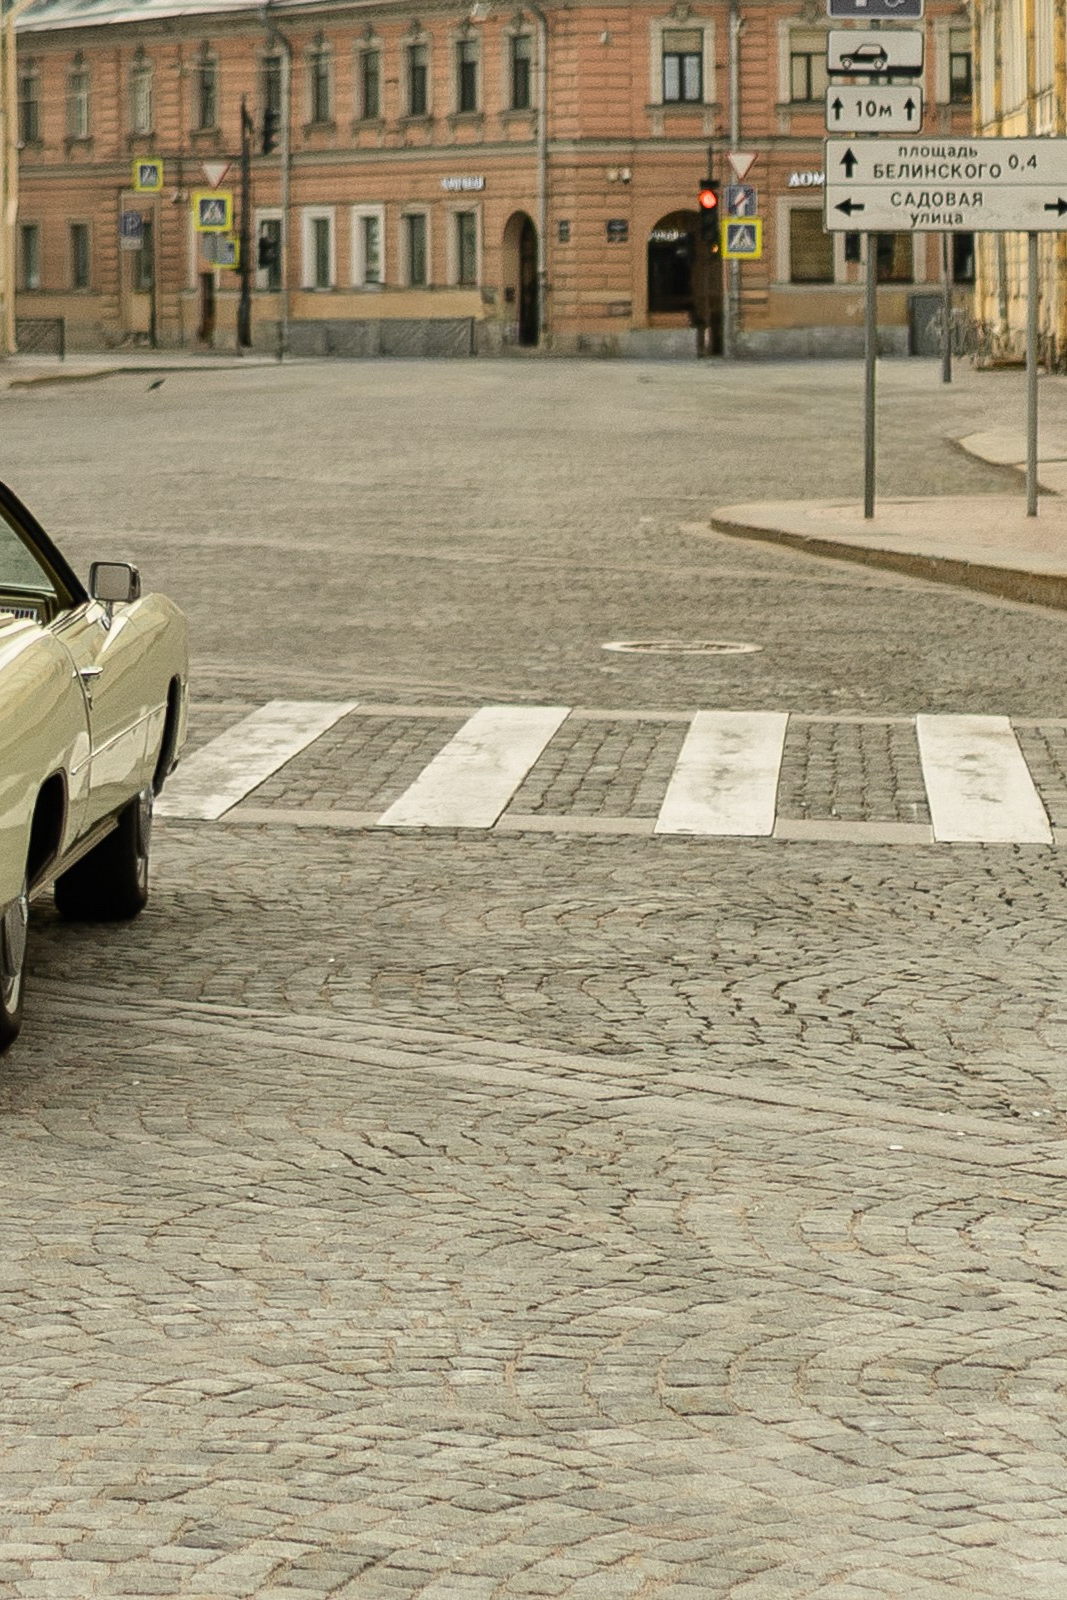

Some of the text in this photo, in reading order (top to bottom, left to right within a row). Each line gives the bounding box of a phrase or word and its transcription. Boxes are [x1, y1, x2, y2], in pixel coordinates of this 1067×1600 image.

[856, 100, 892, 117] 10м
[898, 146, 978, 159] площадь
[1008, 154, 1038, 171] 0,4
[873, 163, 1002, 179] БЕЛИНСКОГО
[890, 191, 983, 208] САДОВАЯ
[910, 212, 964, 228] улица
